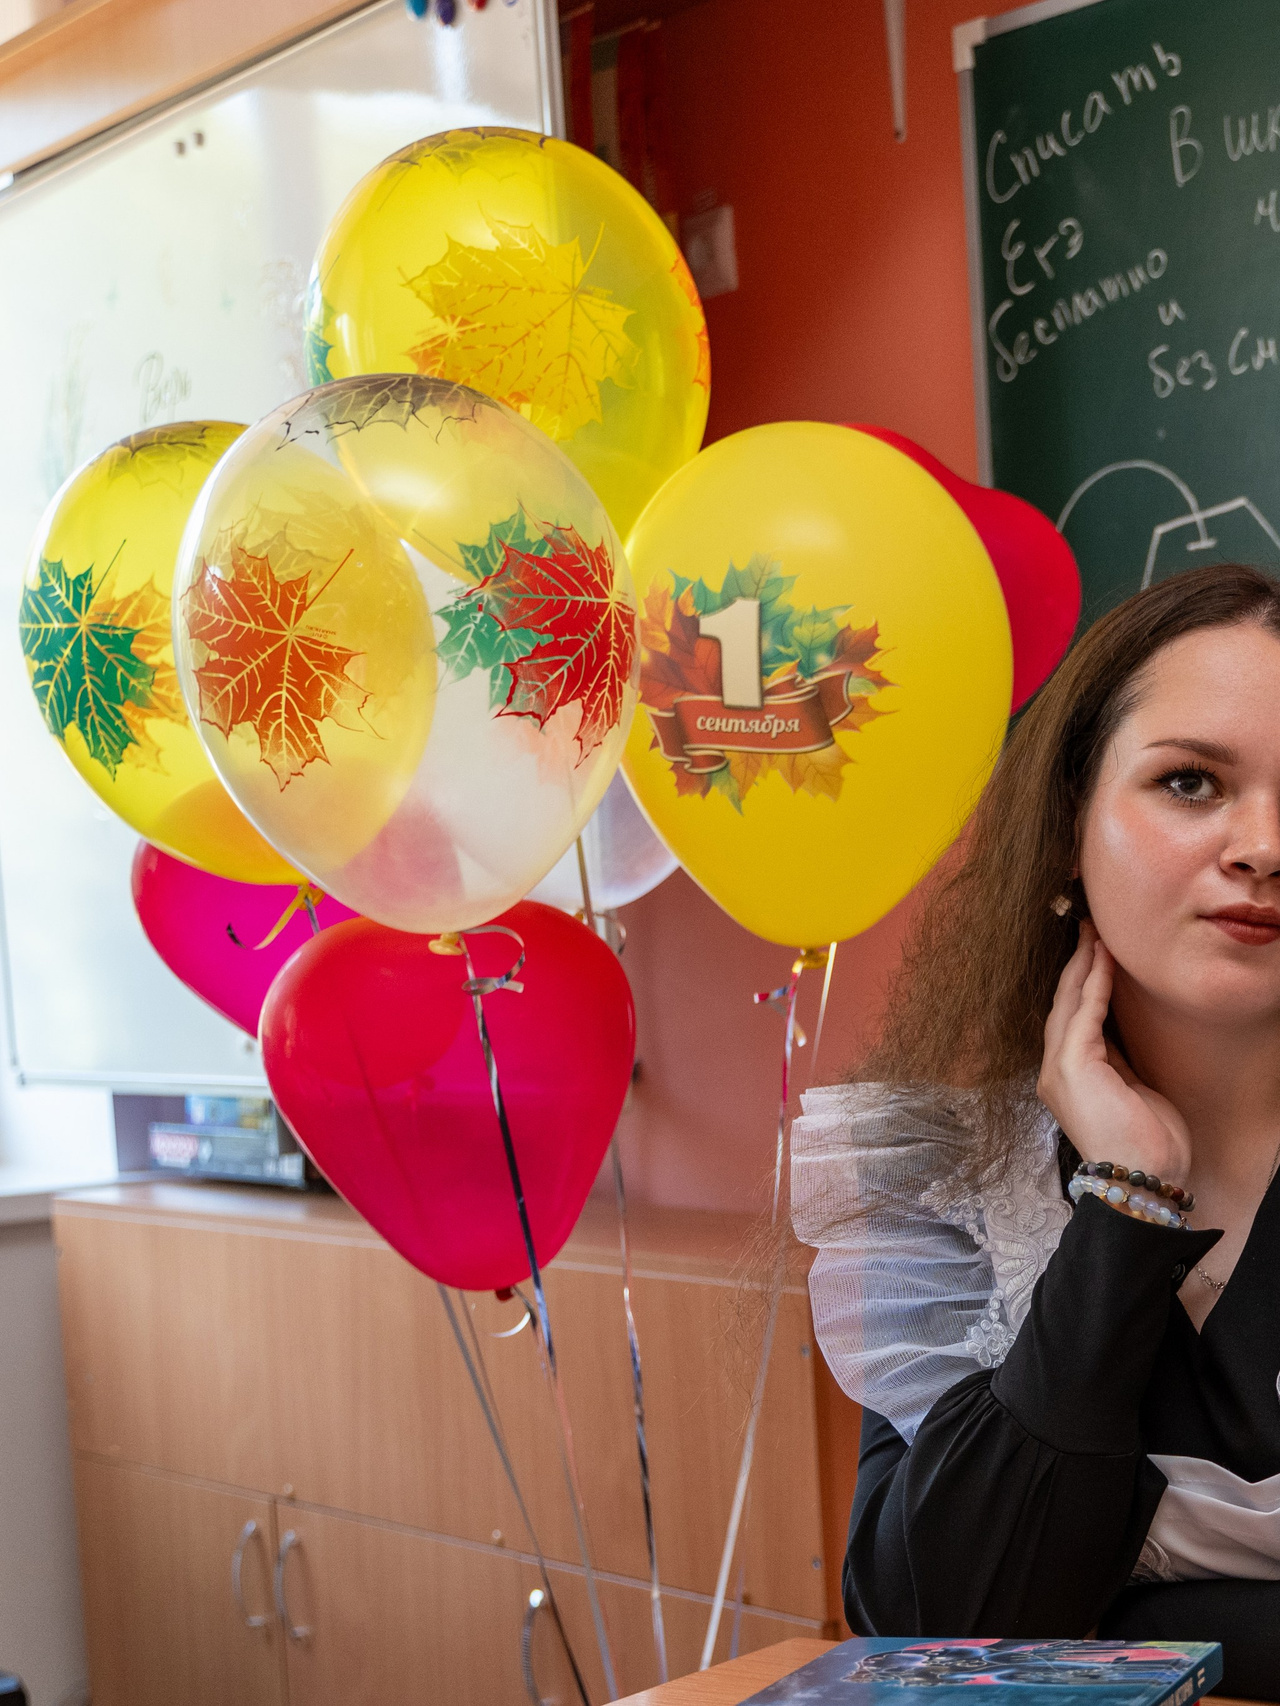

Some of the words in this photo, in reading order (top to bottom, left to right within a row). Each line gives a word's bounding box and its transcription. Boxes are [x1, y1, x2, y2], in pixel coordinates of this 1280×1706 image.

[985, 42, 1182, 204] Списать
[987, 248, 1168, 383] бесплатно
[1158, 300, 1186, 326] и
[1147, 343, 1218, 399] без
[698, 596, 762, 710] 1
[696, 714, 802, 740] сентября
